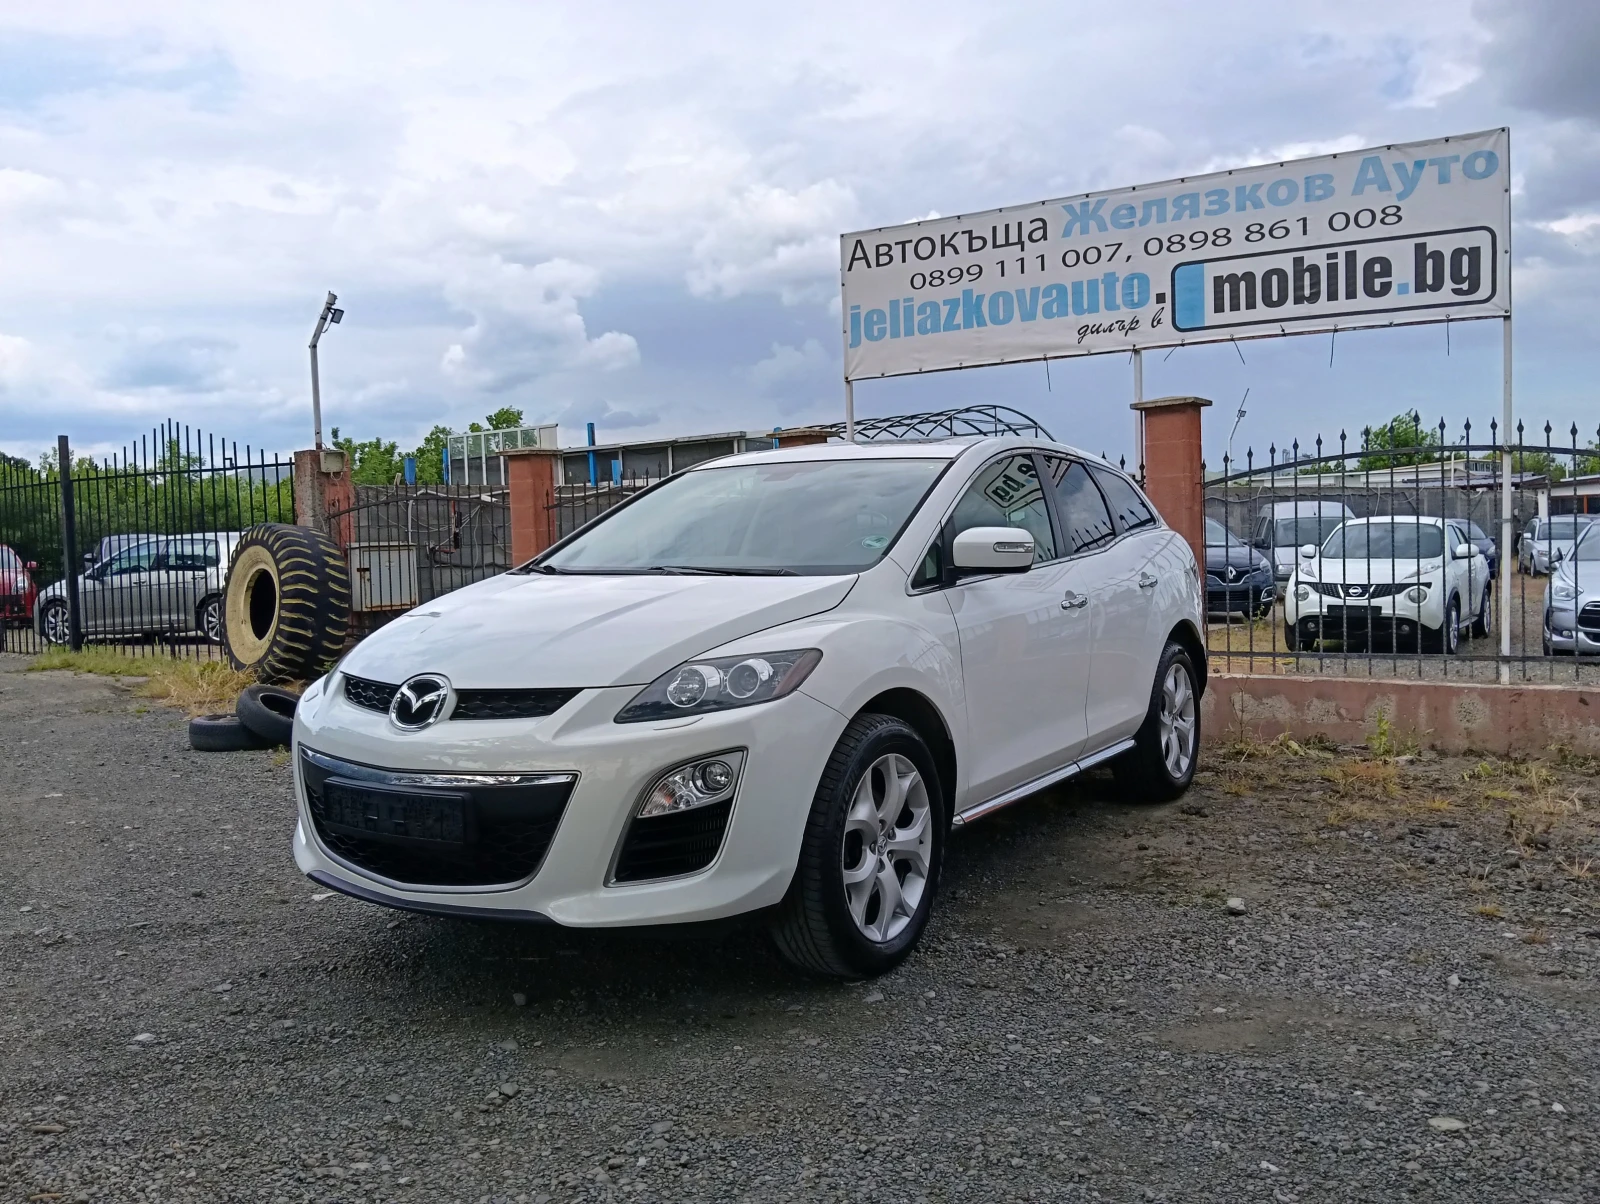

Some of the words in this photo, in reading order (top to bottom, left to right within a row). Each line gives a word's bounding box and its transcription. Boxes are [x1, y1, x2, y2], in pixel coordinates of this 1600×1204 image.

[847, 216, 1048, 272] Автокъща
[1061, 173, 1336, 238] Желязков
[1351, 150, 1499, 201] Ауто
[910, 263, 984, 290] 0899
[995, 253, 1046, 278] 111
[1061, 242, 1133, 268] 007,
[1143, 227, 1233, 256] 0898
[1244, 216, 1308, 243] 861
[1328, 204, 1403, 232] 008
[1213, 242, 1482, 314] mobile.bg
[1077, 315, 1141, 344] дилър
